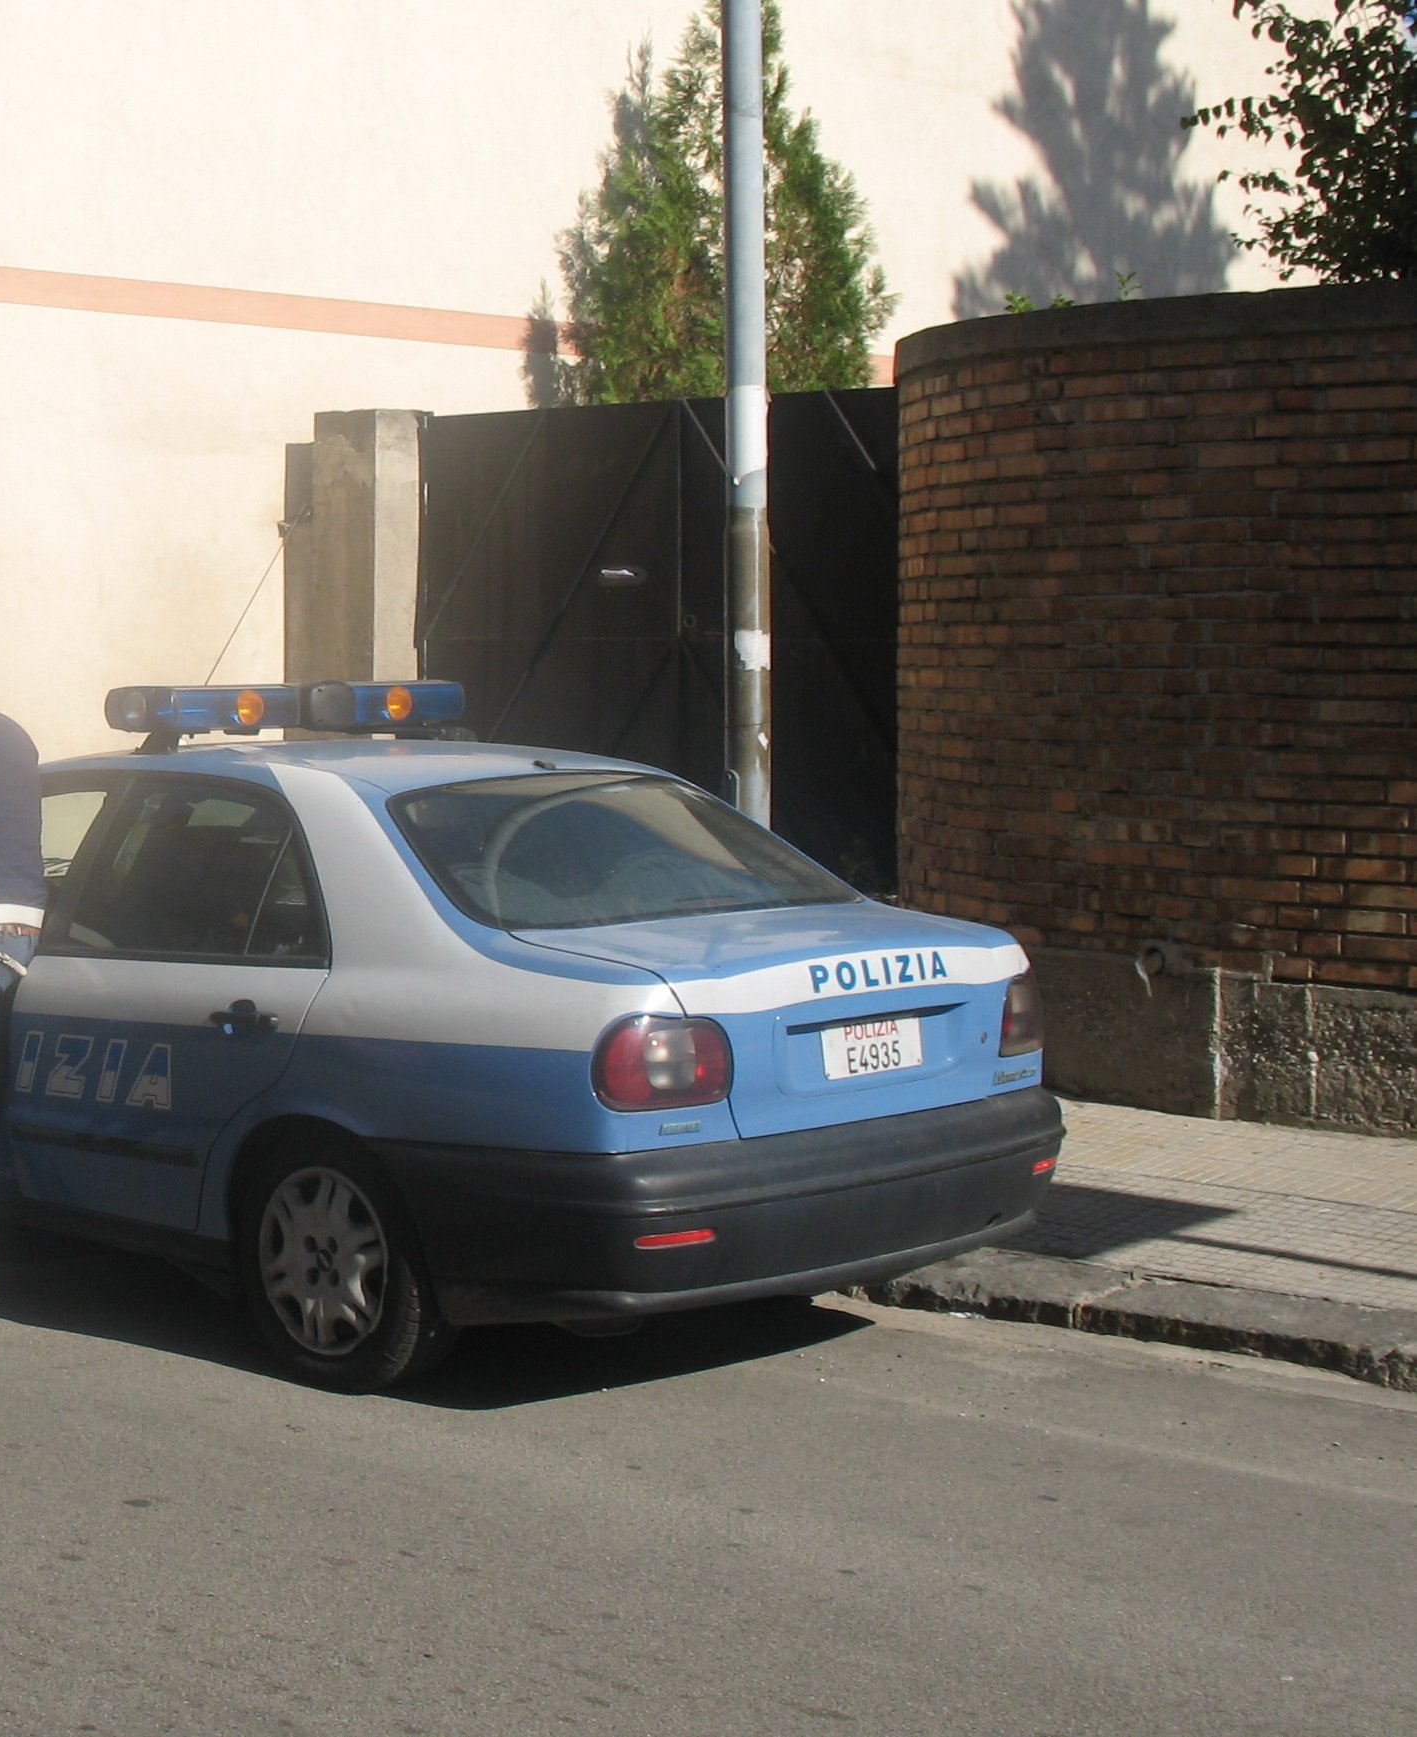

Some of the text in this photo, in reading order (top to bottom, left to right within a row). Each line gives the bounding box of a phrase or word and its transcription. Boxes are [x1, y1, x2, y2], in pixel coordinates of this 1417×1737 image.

[808, 950, 948, 994] POLIZIA
[843, 1020, 900, 1041] POLIZIA
[846, 1040, 902, 1074] E4935
